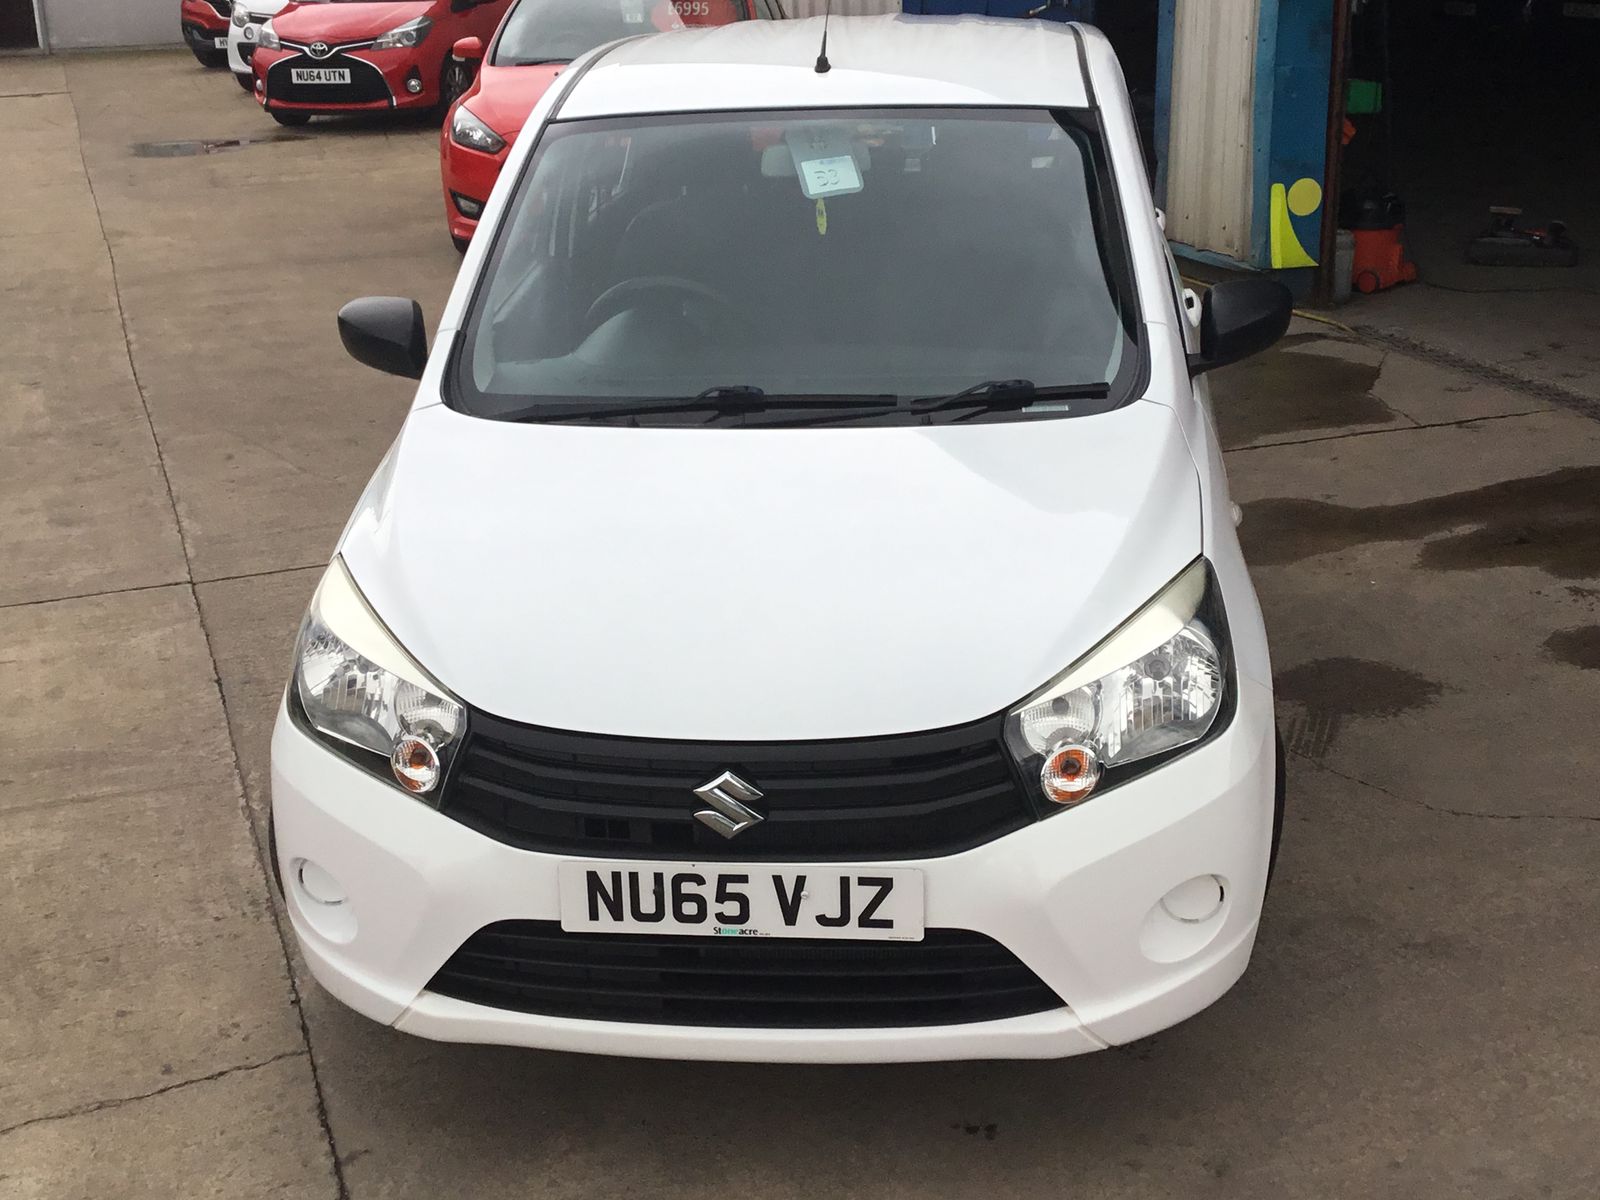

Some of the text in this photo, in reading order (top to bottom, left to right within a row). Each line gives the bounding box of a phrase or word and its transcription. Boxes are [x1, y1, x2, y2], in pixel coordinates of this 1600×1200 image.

[296, 70, 346, 82] NU64 UTN
[586, 870, 894, 930] NU65 VJZ
[713, 926, 758, 936] Stoneacre
